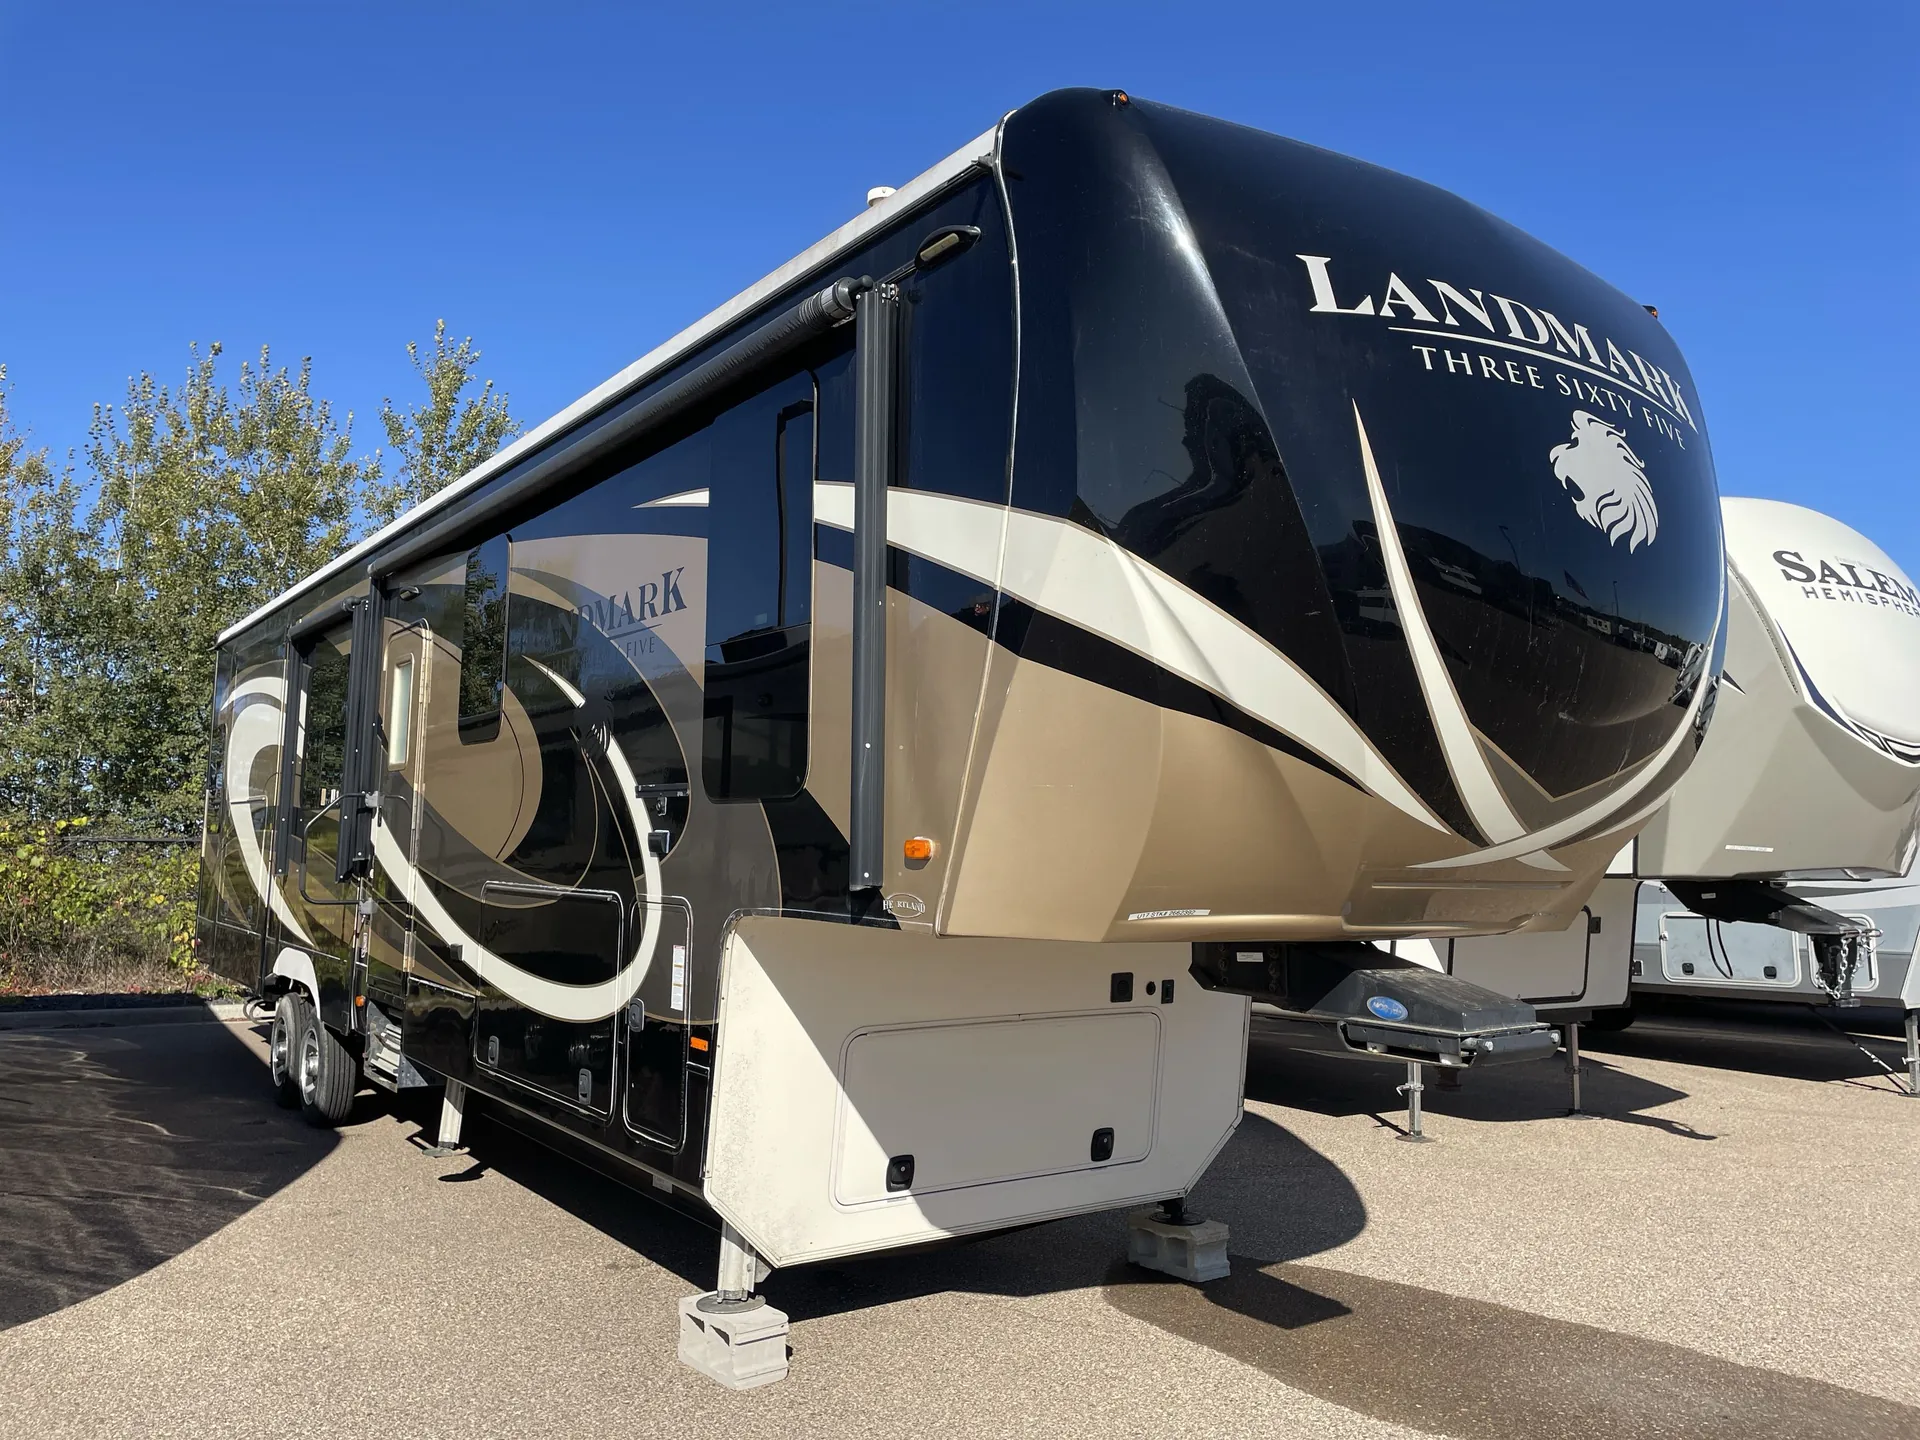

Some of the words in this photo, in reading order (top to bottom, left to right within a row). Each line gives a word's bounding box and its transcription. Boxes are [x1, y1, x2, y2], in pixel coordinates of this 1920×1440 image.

[1296, 253, 1698, 434] LANDMARK
[1412, 344, 1545, 390] THREE
[1555, 372, 1633, 419] SIXTY
[1642, 407, 1687, 451] FIVE
[1772, 549, 1920, 609] SALEM
[626, 636, 656, 659] FIVE
[882, 899, 926, 914] HERTLAND
